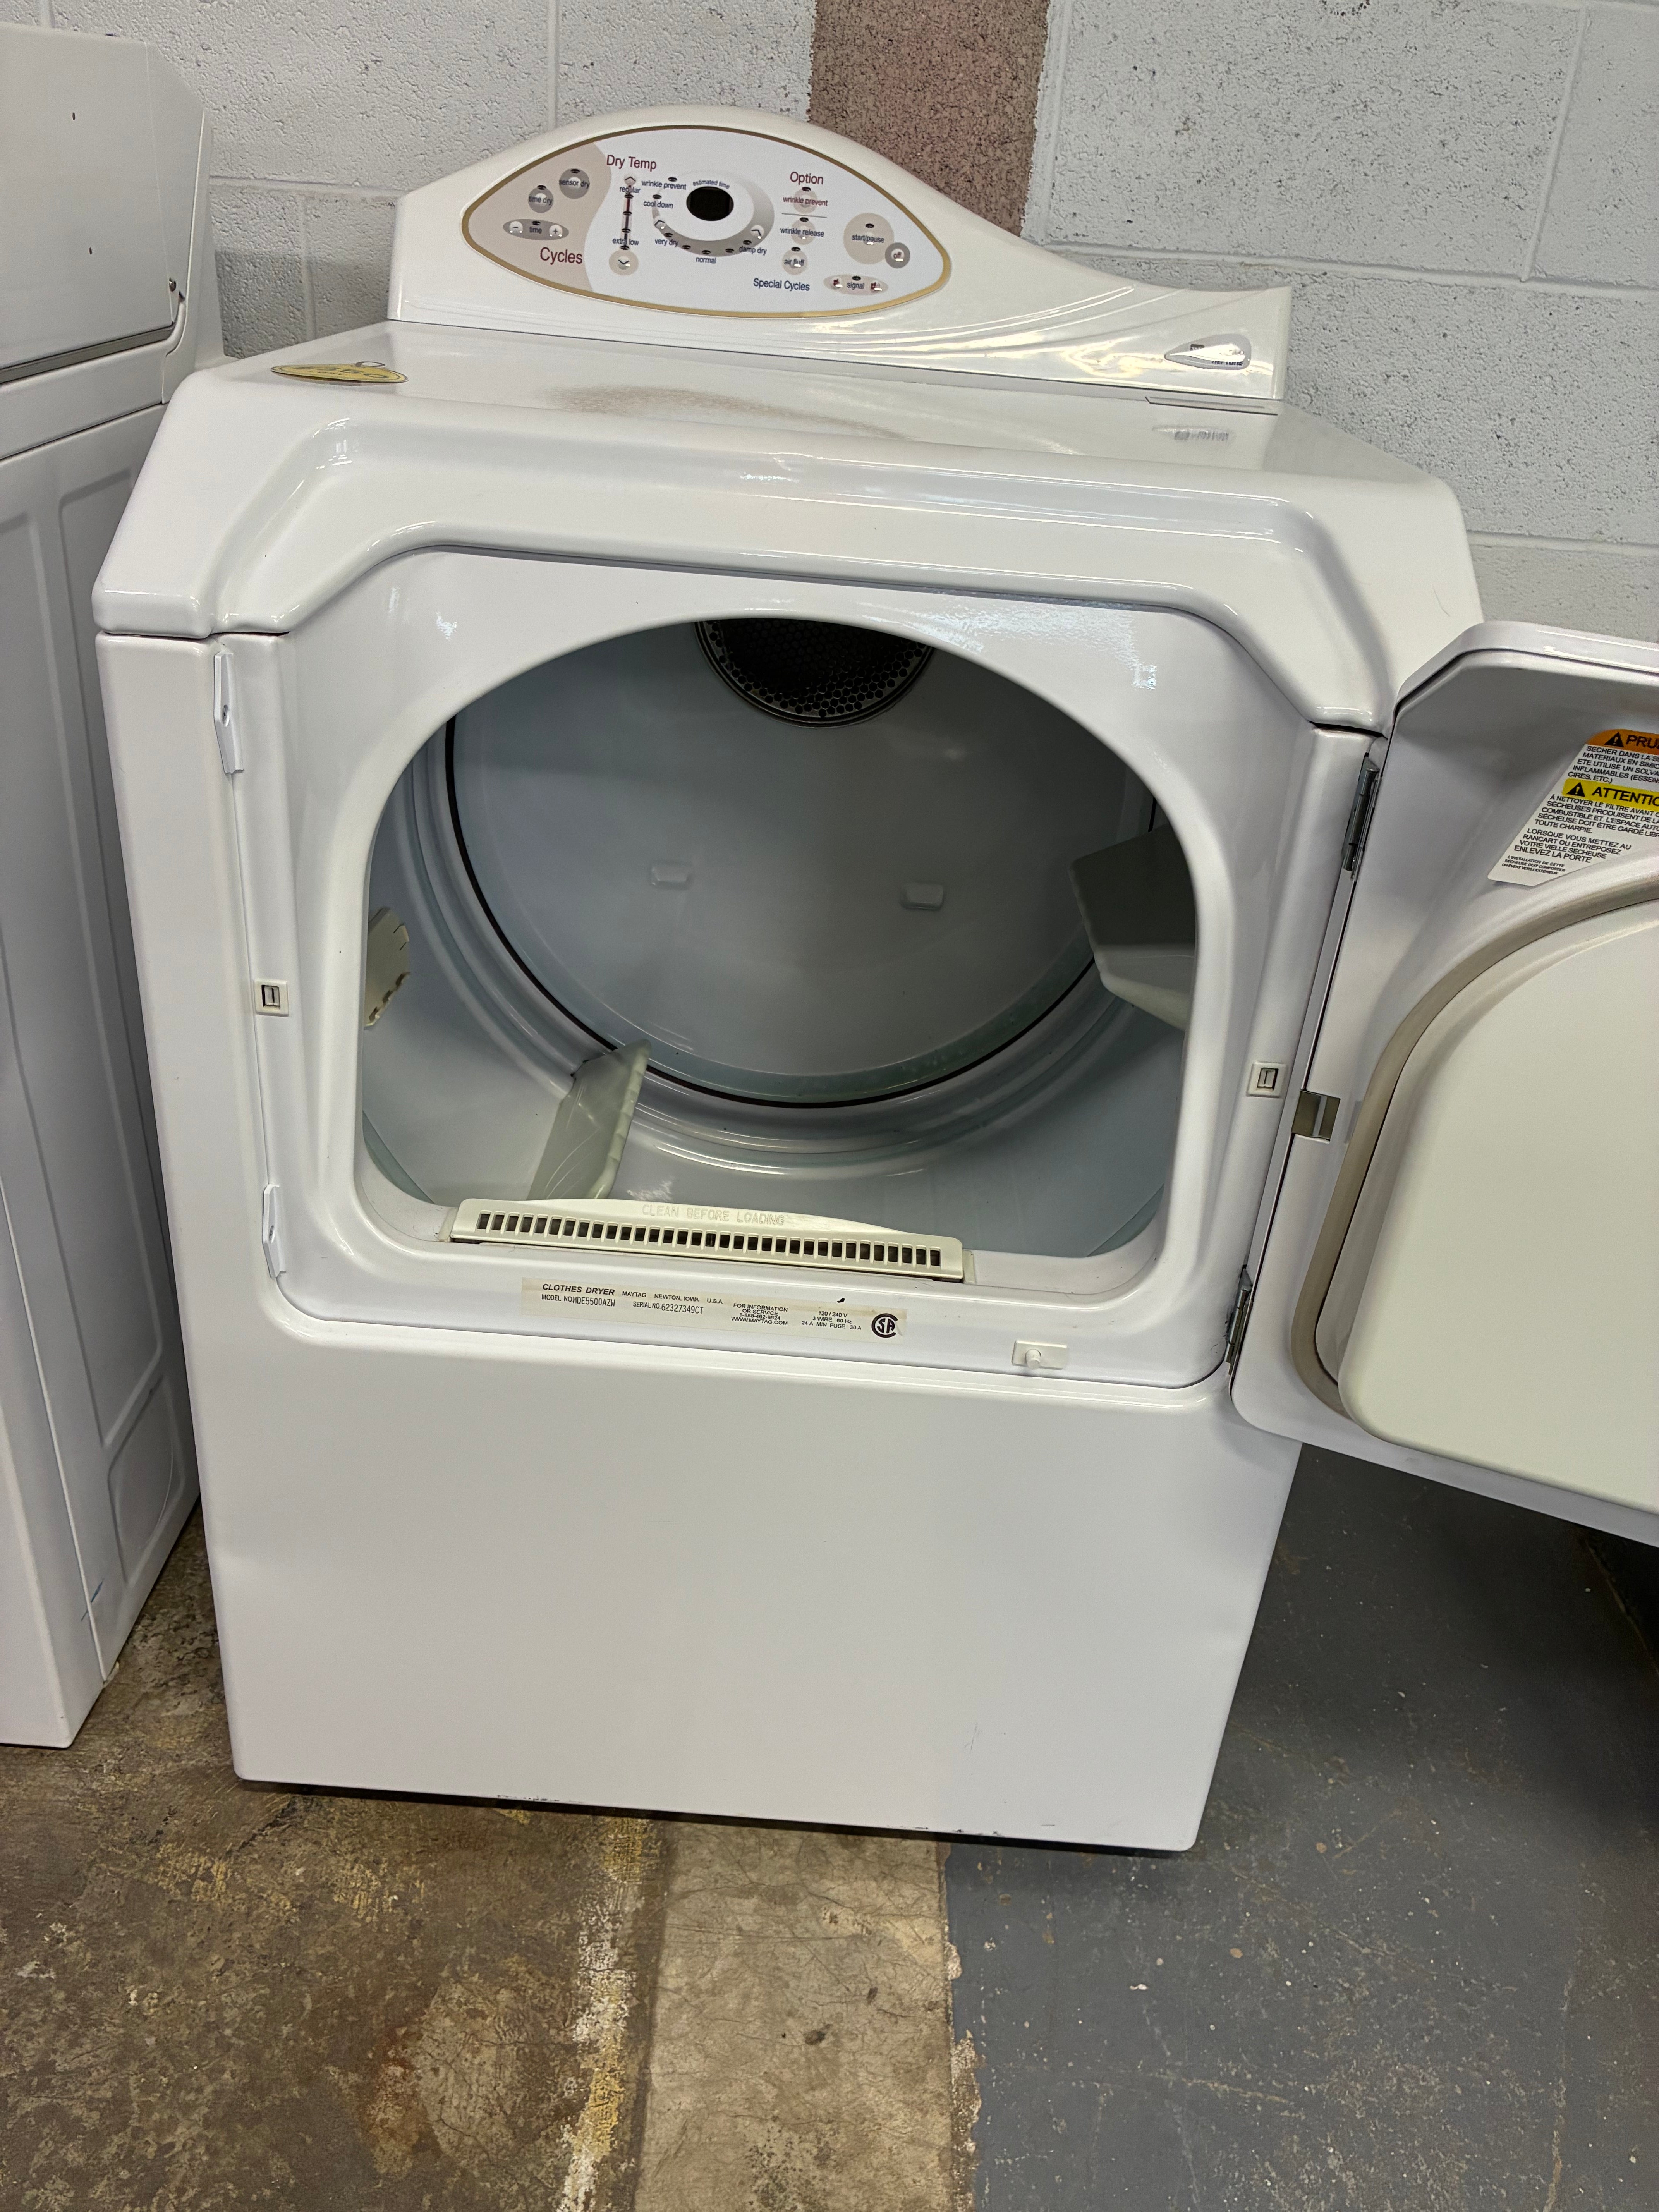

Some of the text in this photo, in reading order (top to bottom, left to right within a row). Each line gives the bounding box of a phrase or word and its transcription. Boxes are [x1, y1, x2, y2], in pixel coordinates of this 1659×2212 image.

[606, 155, 657, 172] Dry Temp
[580, 180, 590, 189] dry
[790, 172, 824, 185] Option
[543, 197, 553, 206] dry
[805, 198, 828, 206] prevent
[802, 229, 824, 237] release
[852, 234, 885, 244] start/pause
[669, 239, 678, 247] dry
[540, 247, 583, 265] Cycles
[739, 245, 767, 256] damp dry
[696, 256, 716, 264] normal
[753, 278, 810, 291] Special Cycles
[847, 282, 865, 290] signal
[1626, 734, 1659, 749] PRU
[1583, 752, 1626, 764] MATERIAUX
[1586, 746, 1618, 755] SECHER
[1619, 750, 1640, 759] DANS
[1573, 765, 1629, 778] INFLAMMABLES
[1593, 761, 1621, 770] UTILISE
[1556, 796, 1593, 806] NETTOYER
[1605, 804, 1630, 812] FILTRE
[1542, 807, 1592, 820] COMBUSTIBLE
[1592, 808, 1640, 820] PRODUISENT
[1535, 819, 1559, 828] TOUTE
[1527, 828, 1564, 839] LORSQUE
[1566, 834, 1587, 842] VOUS
[1588, 838, 1619, 848] METTEZ
[1520, 840, 1544, 848] VOTRE
[1568, 848, 1607, 859] SECHEUSE
[1523, 834, 1558, 844] RANCART
[1571, 842, 1621, 855] ENTREPOSEZ
[1514, 845, 1551, 856] ENLEVEZ
[1563, 853, 1592, 863] PORTE
[642, 1204, 785, 1226] CLEAN BEFORE LOADING
[542, 1283, 582, 1293] CLOTHES
[585, 1287, 615, 1296] DRYER
[661, 1303, 704, 1315] 62327349CT
[747, 1304, 788, 1312] INFORMATION
[731, 1317, 788, 1326] WWW.MAYTAG.COM
